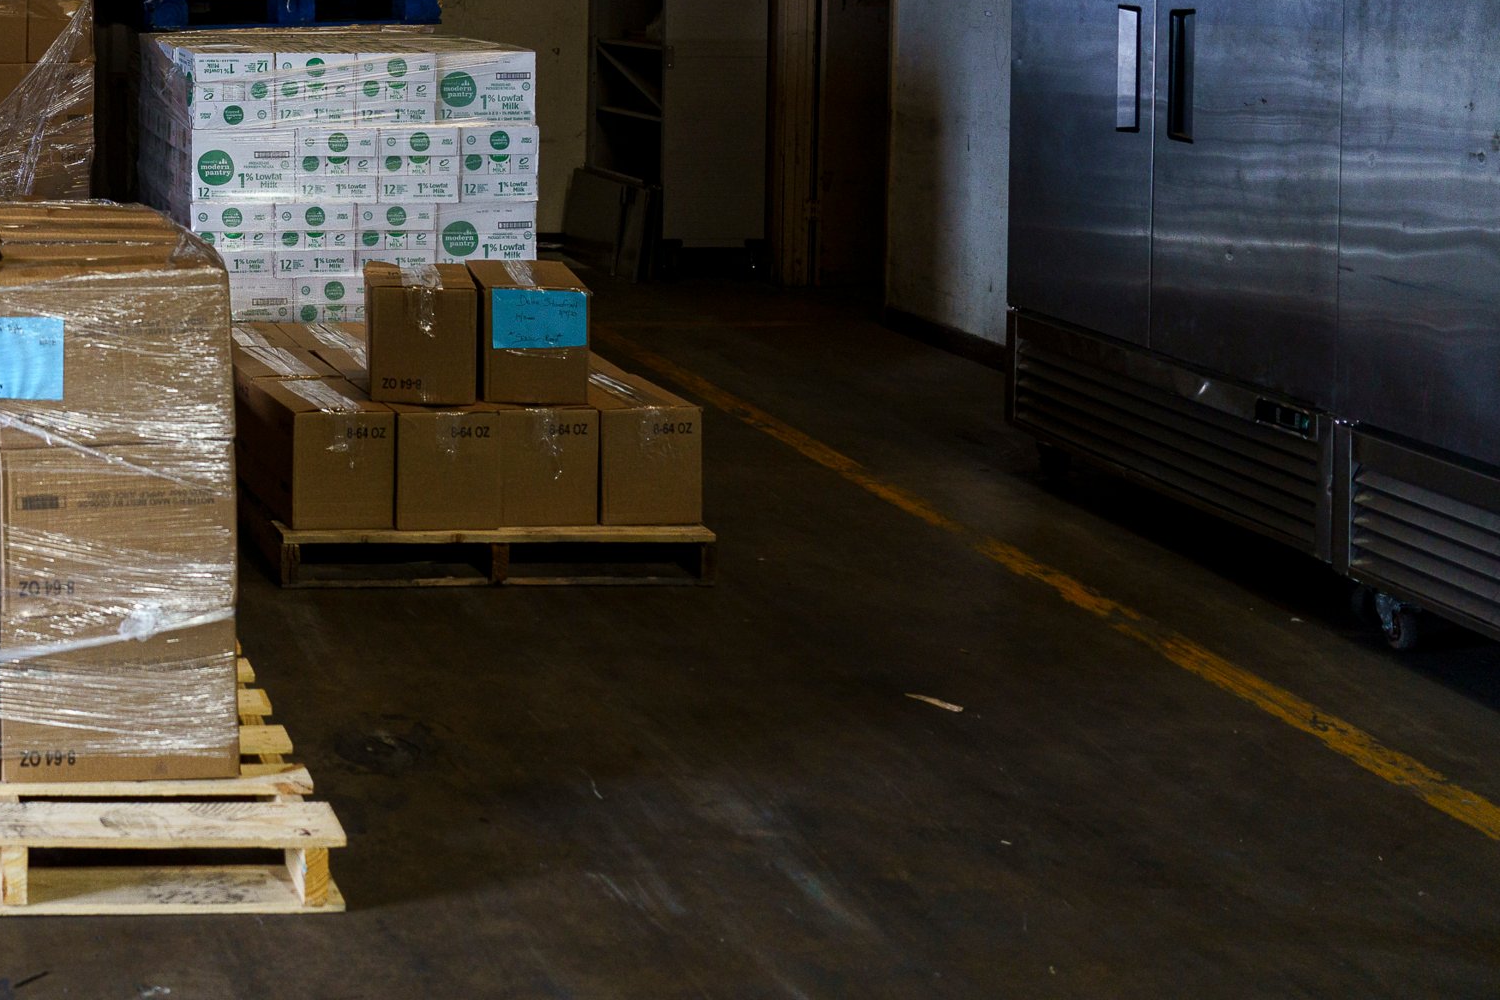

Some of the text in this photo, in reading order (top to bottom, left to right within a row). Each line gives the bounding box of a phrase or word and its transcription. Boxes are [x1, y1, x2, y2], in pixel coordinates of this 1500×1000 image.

[225, 63, 235, 73] 1%
[257, 62, 268, 73] 12
[447, 91, 474, 99] pantry
[480, 94, 524, 110] 1% Lowfat
[502, 102, 519, 110] Milk
[361, 109, 373, 120] 12
[439, 108, 453, 119] 12
[205, 169, 232, 177] pantry
[238, 172, 283, 188] 1% Lowfat
[198, 187, 210, 198] 12
[383, 184, 396, 194] 12
[418, 183, 428, 193] 1%
[464, 183, 477, 194] 12
[498, 182, 509, 192] 1%
[482, 243, 526, 258] 1% Lowfat
[233, 259, 245, 270] 1%
[280, 259, 292, 269] 12
[313, 258, 325, 268] 1%
[382, 377, 422, 390] 8-64 OZ
[346, 427, 386, 439] 8-64 OZ
[451, 427, 490, 438] 8-64 OZ
[549, 423, 588, 436] 8-64 OZ
[653, 422, 693, 435] 8-64 OZ
[18, 580, 76, 597] 8-64 OZ
[19, 751, 76, 767] 8-64 OZ
